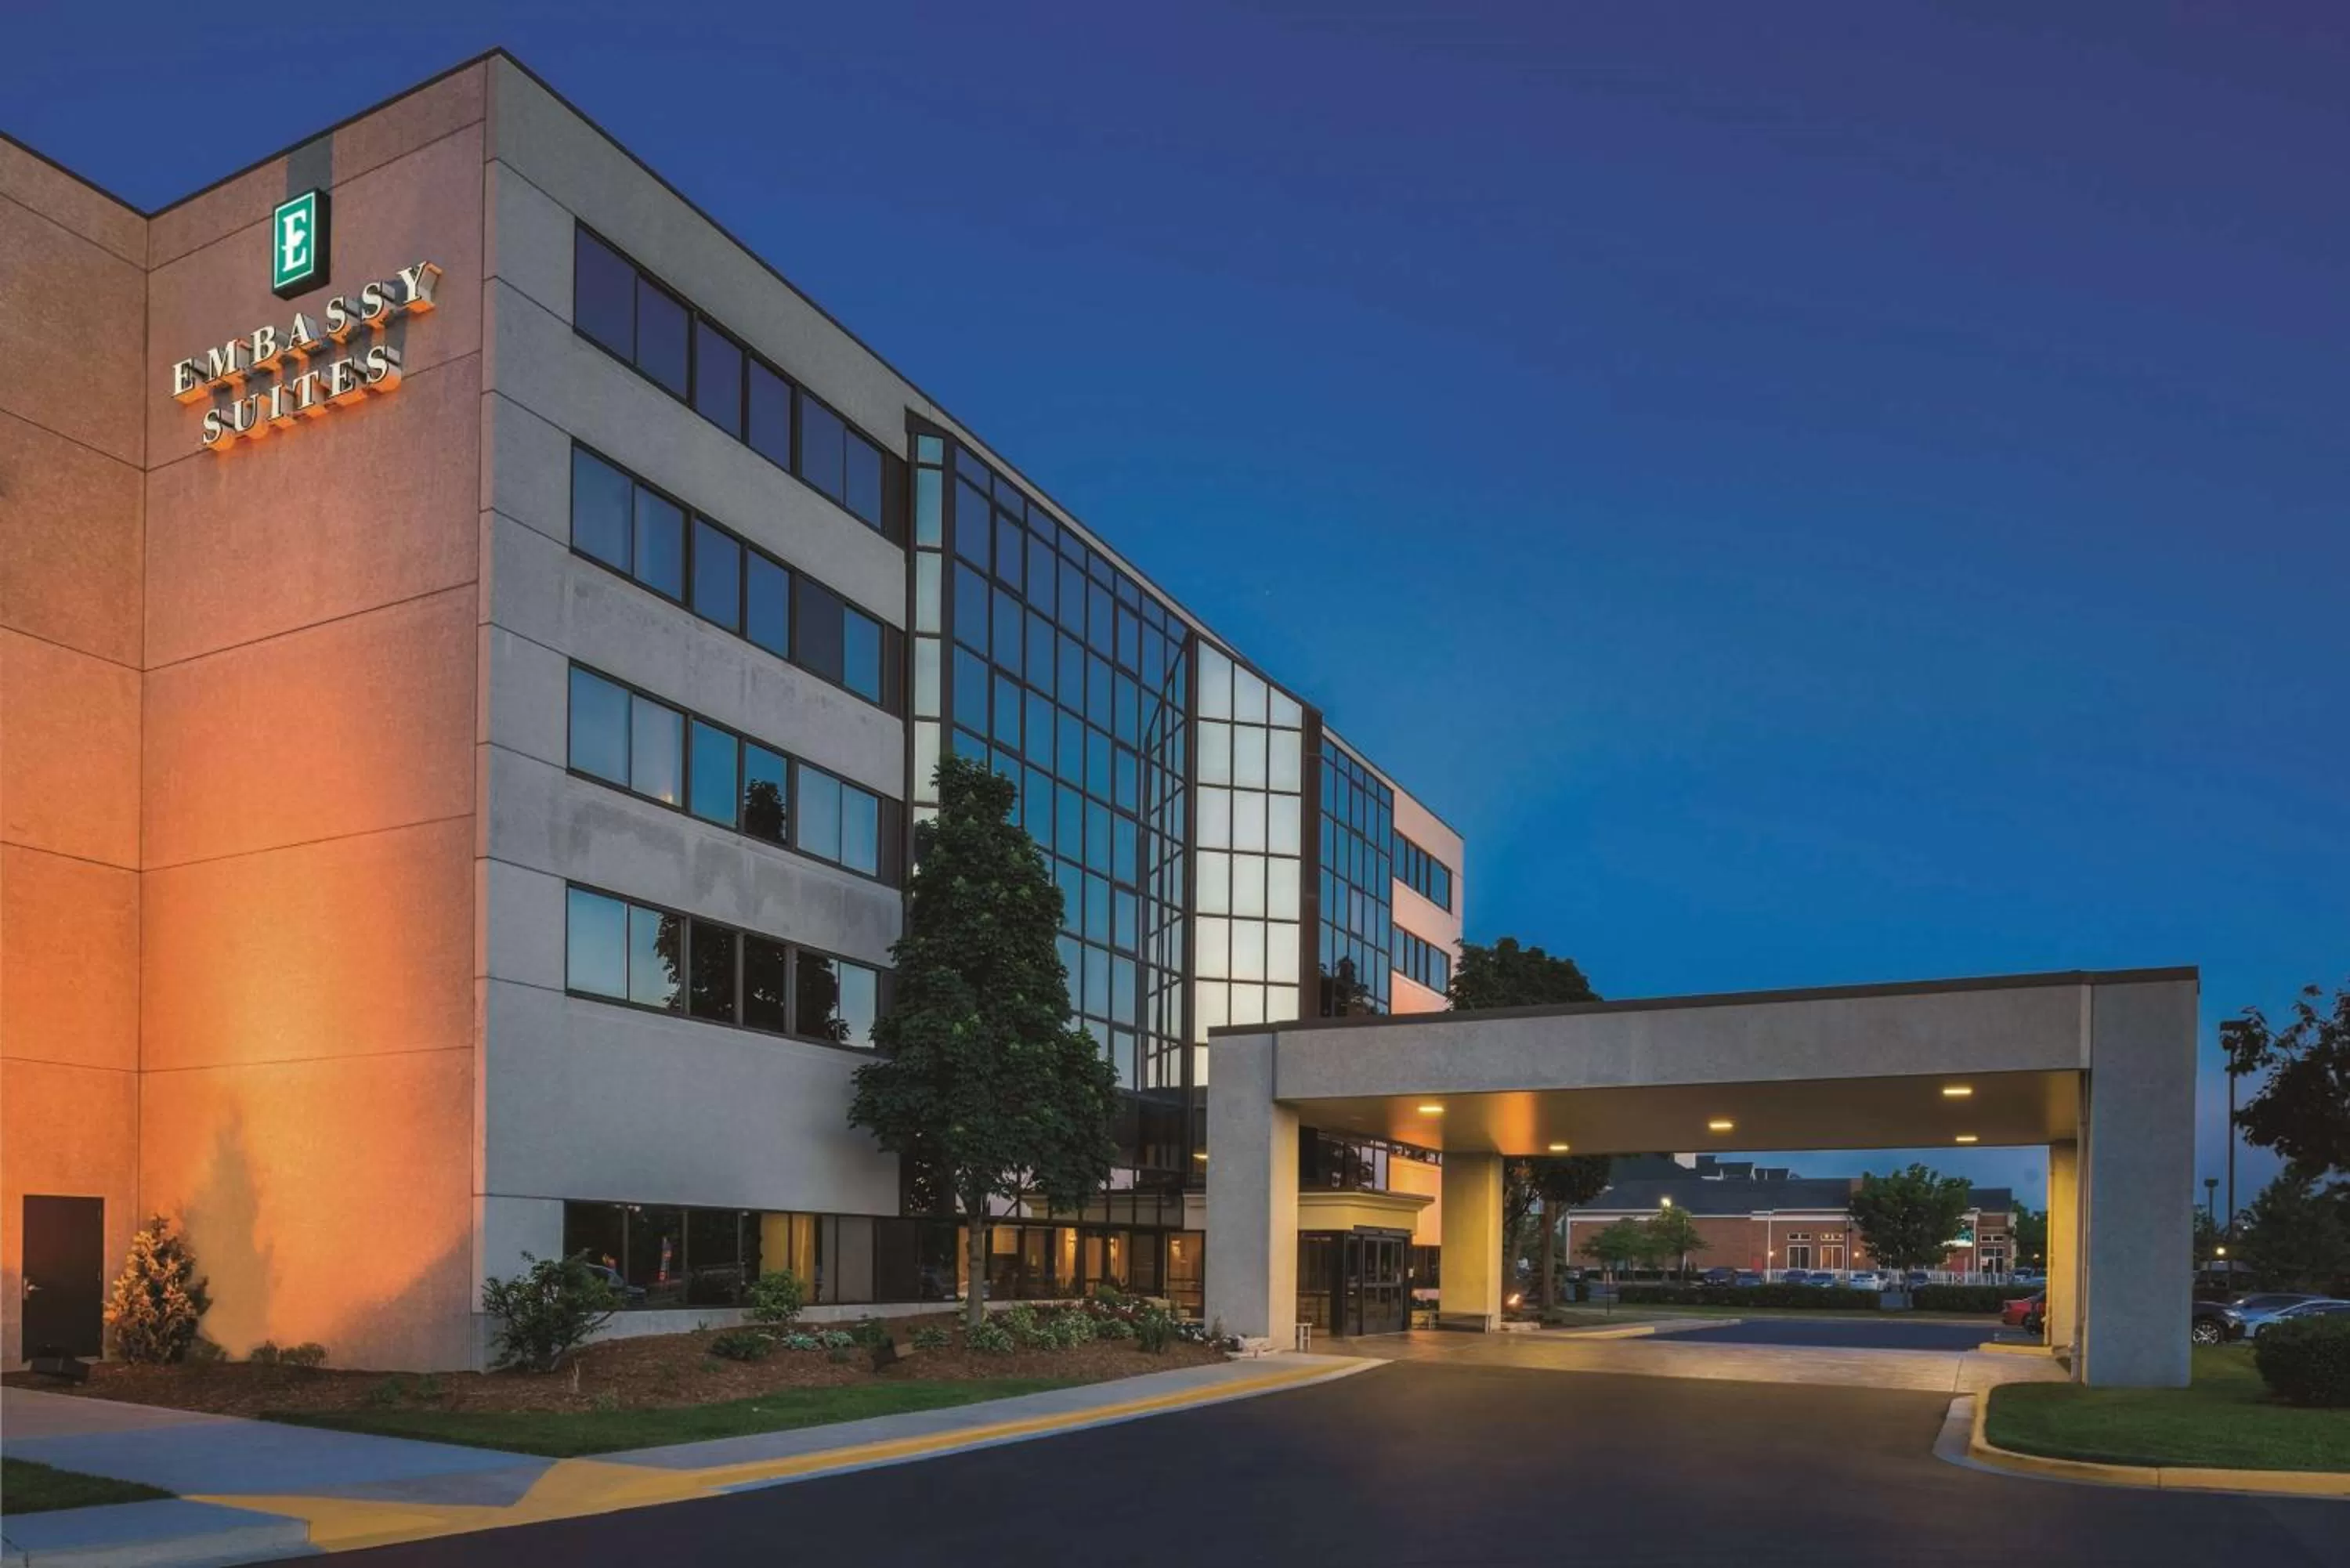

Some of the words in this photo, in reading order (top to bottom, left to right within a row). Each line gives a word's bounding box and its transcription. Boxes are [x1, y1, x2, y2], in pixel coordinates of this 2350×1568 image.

[282, 209, 307, 272] E
[172, 261, 428, 398] EMBASSY
[201, 345, 389, 446] SUITES
